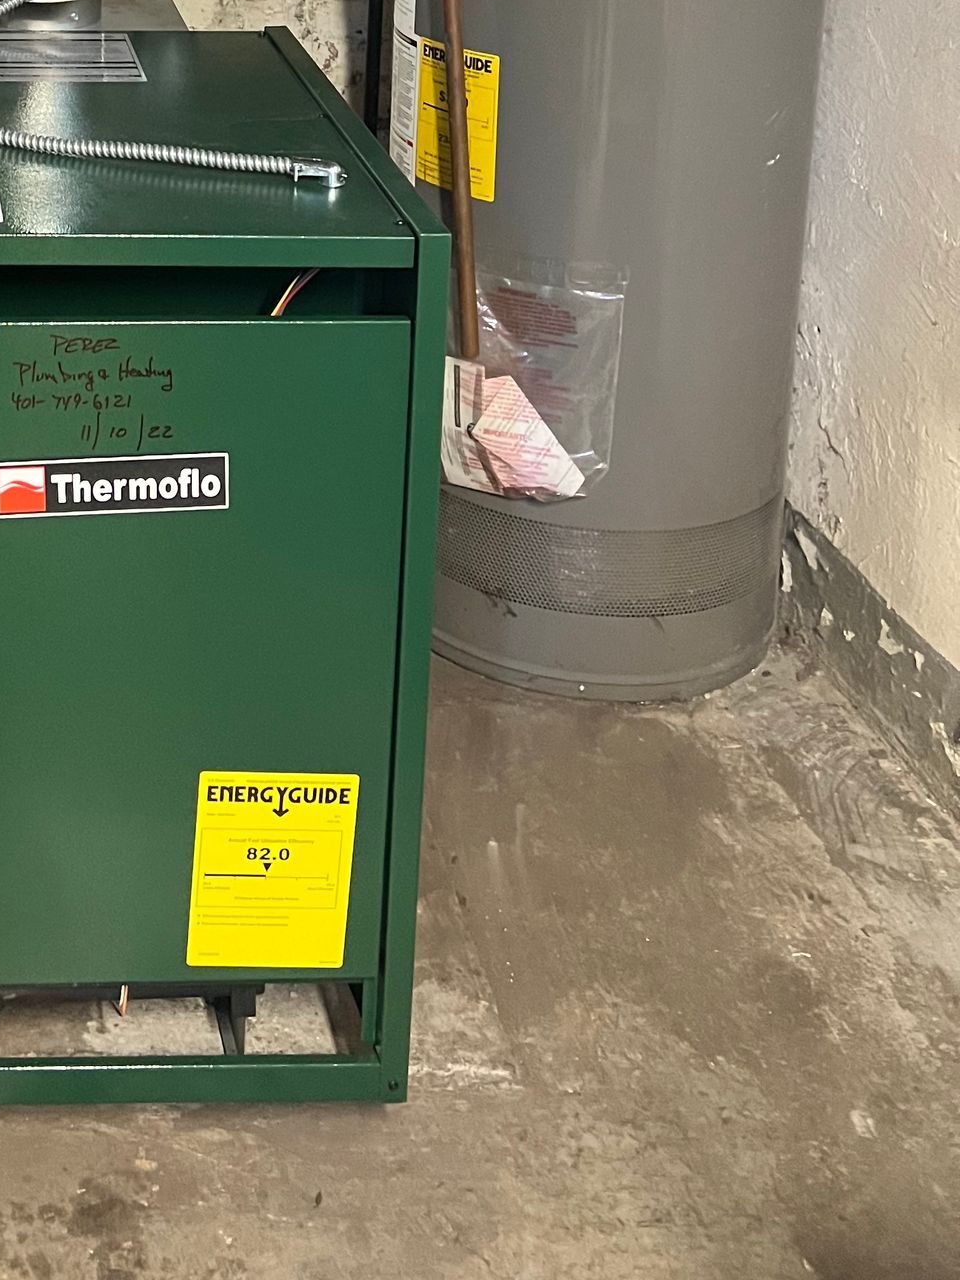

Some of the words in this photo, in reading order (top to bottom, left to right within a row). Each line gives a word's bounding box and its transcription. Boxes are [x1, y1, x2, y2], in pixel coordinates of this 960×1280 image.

[423, 43, 493, 74] ENERUIDE
[50, 334, 121, 356] PEREZ
[12, 360, 94, 391] Plumbing
[118, 355, 174, 391] Heating
[50, 467, 222, 504] Thermoflo
[206, 785, 352, 810] ENERGYGUIDE
[246, 847, 290, 861] 82.0
